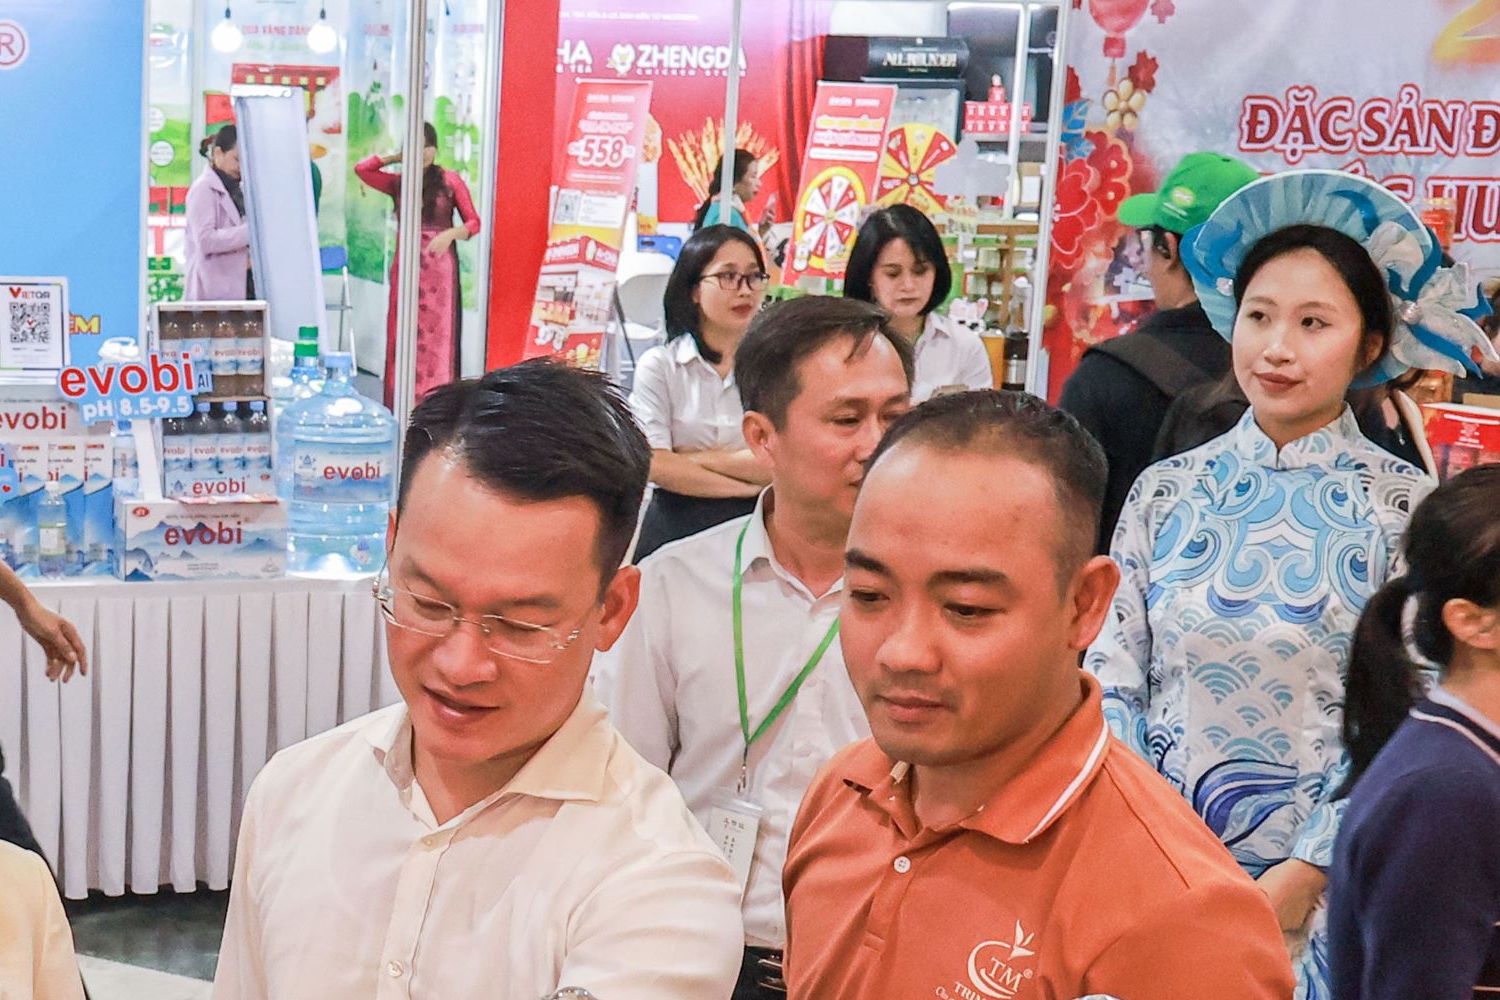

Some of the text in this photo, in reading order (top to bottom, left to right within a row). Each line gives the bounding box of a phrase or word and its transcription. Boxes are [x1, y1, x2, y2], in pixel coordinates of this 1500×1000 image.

[1241, 86, 1351, 162] ĐẶC
[1358, 85, 1465, 155] SẢN
[581, 138, 625, 165] 558
[60, 352, 194, 397] evobi
[83, 396, 190, 420] pH 8.5-9.5
[322, 461, 382, 481] evobi
[192, 477, 246, 496] evobi
[163, 520, 243, 547] evobi
[986, 957, 1023, 993] TM
